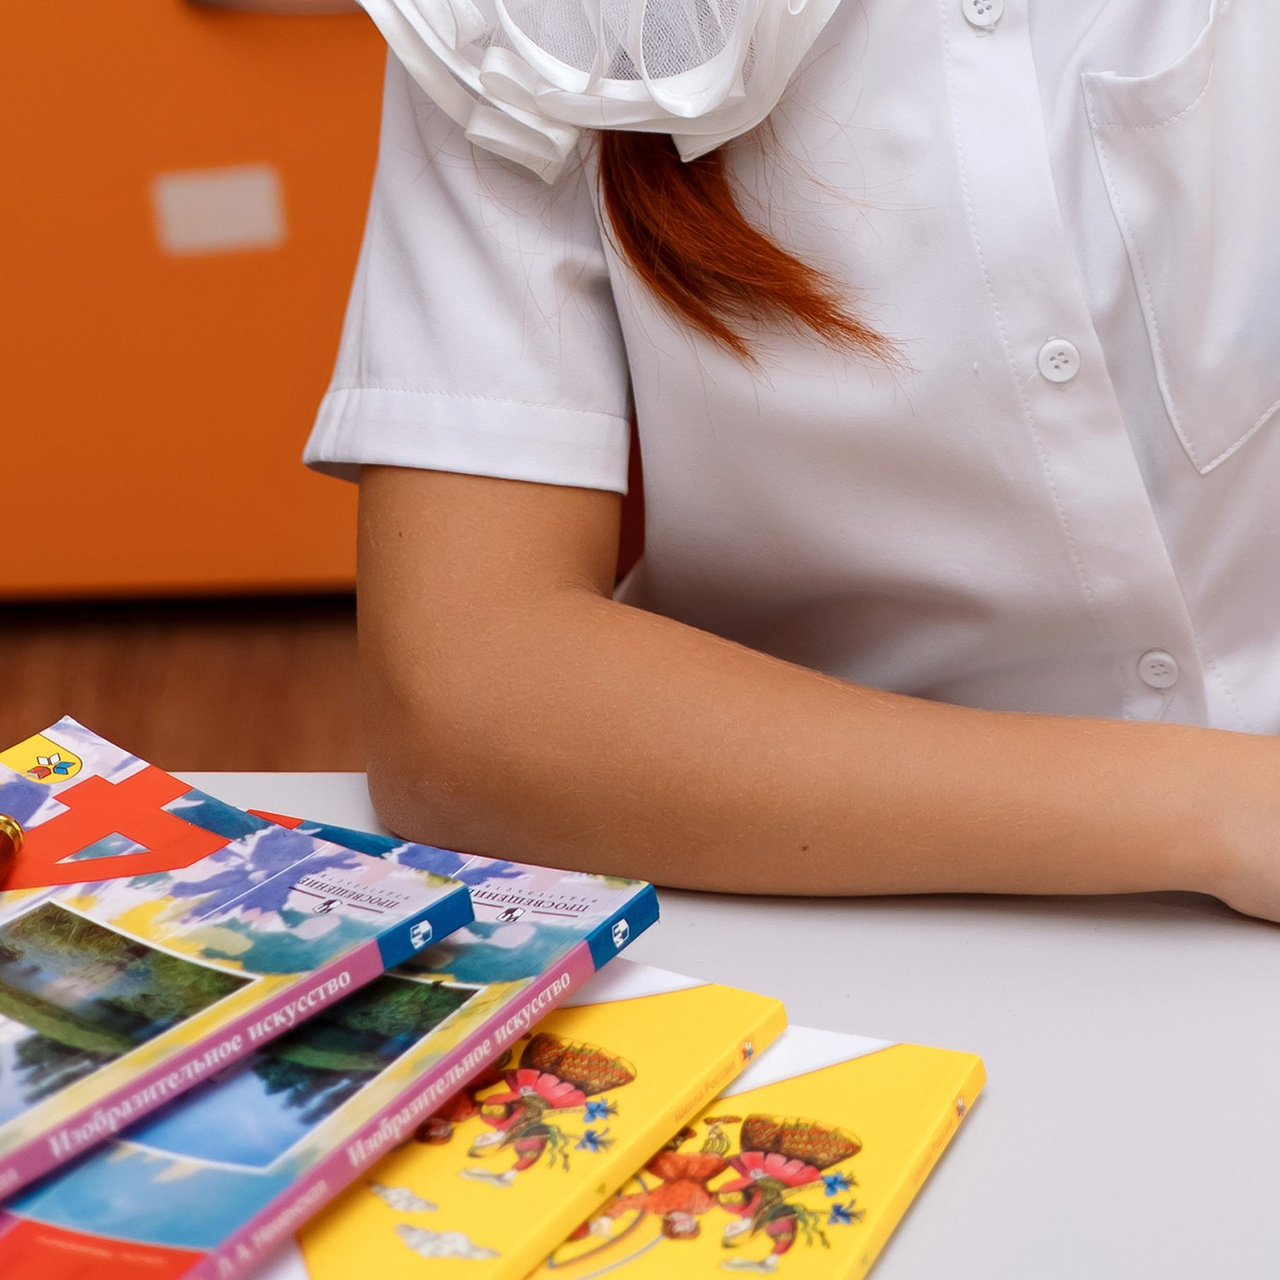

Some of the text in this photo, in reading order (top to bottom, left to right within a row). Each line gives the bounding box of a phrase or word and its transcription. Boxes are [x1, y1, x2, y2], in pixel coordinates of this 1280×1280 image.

[50, 970, 352, 1160] Изобразительное искусство
[346, 972, 572, 1170] Изобразительное искусство
